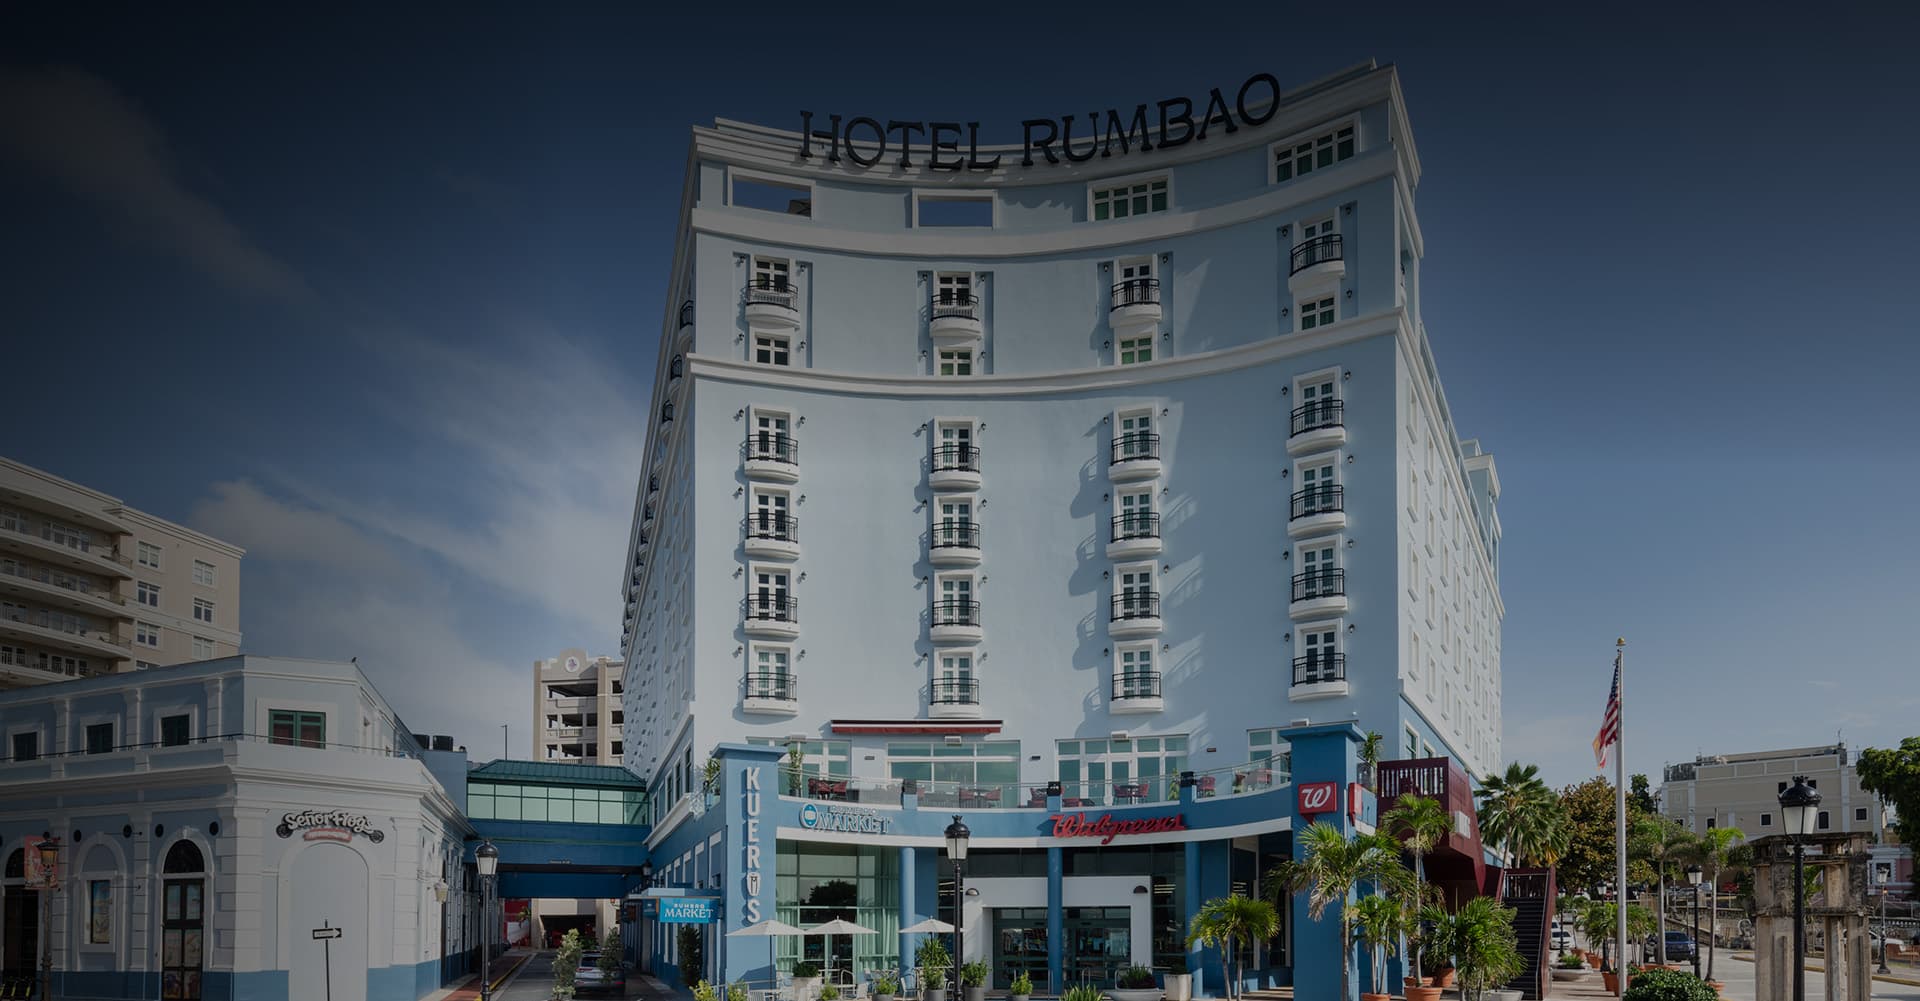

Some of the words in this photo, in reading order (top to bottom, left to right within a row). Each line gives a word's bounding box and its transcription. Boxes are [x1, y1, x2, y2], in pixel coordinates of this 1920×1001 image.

[799, 110, 1001, 171] HOTEL
[1021, 72, 1281, 167] RUMBAO
[1301, 785, 1331, 808] W
[283, 811, 333, 830] Señor
[818, 812, 891, 833] MARKET
[1050, 812, 1186, 844] Walgreens
[746, 766, 761, 923] KUEROS
[664, 908, 714, 919] MARKET
